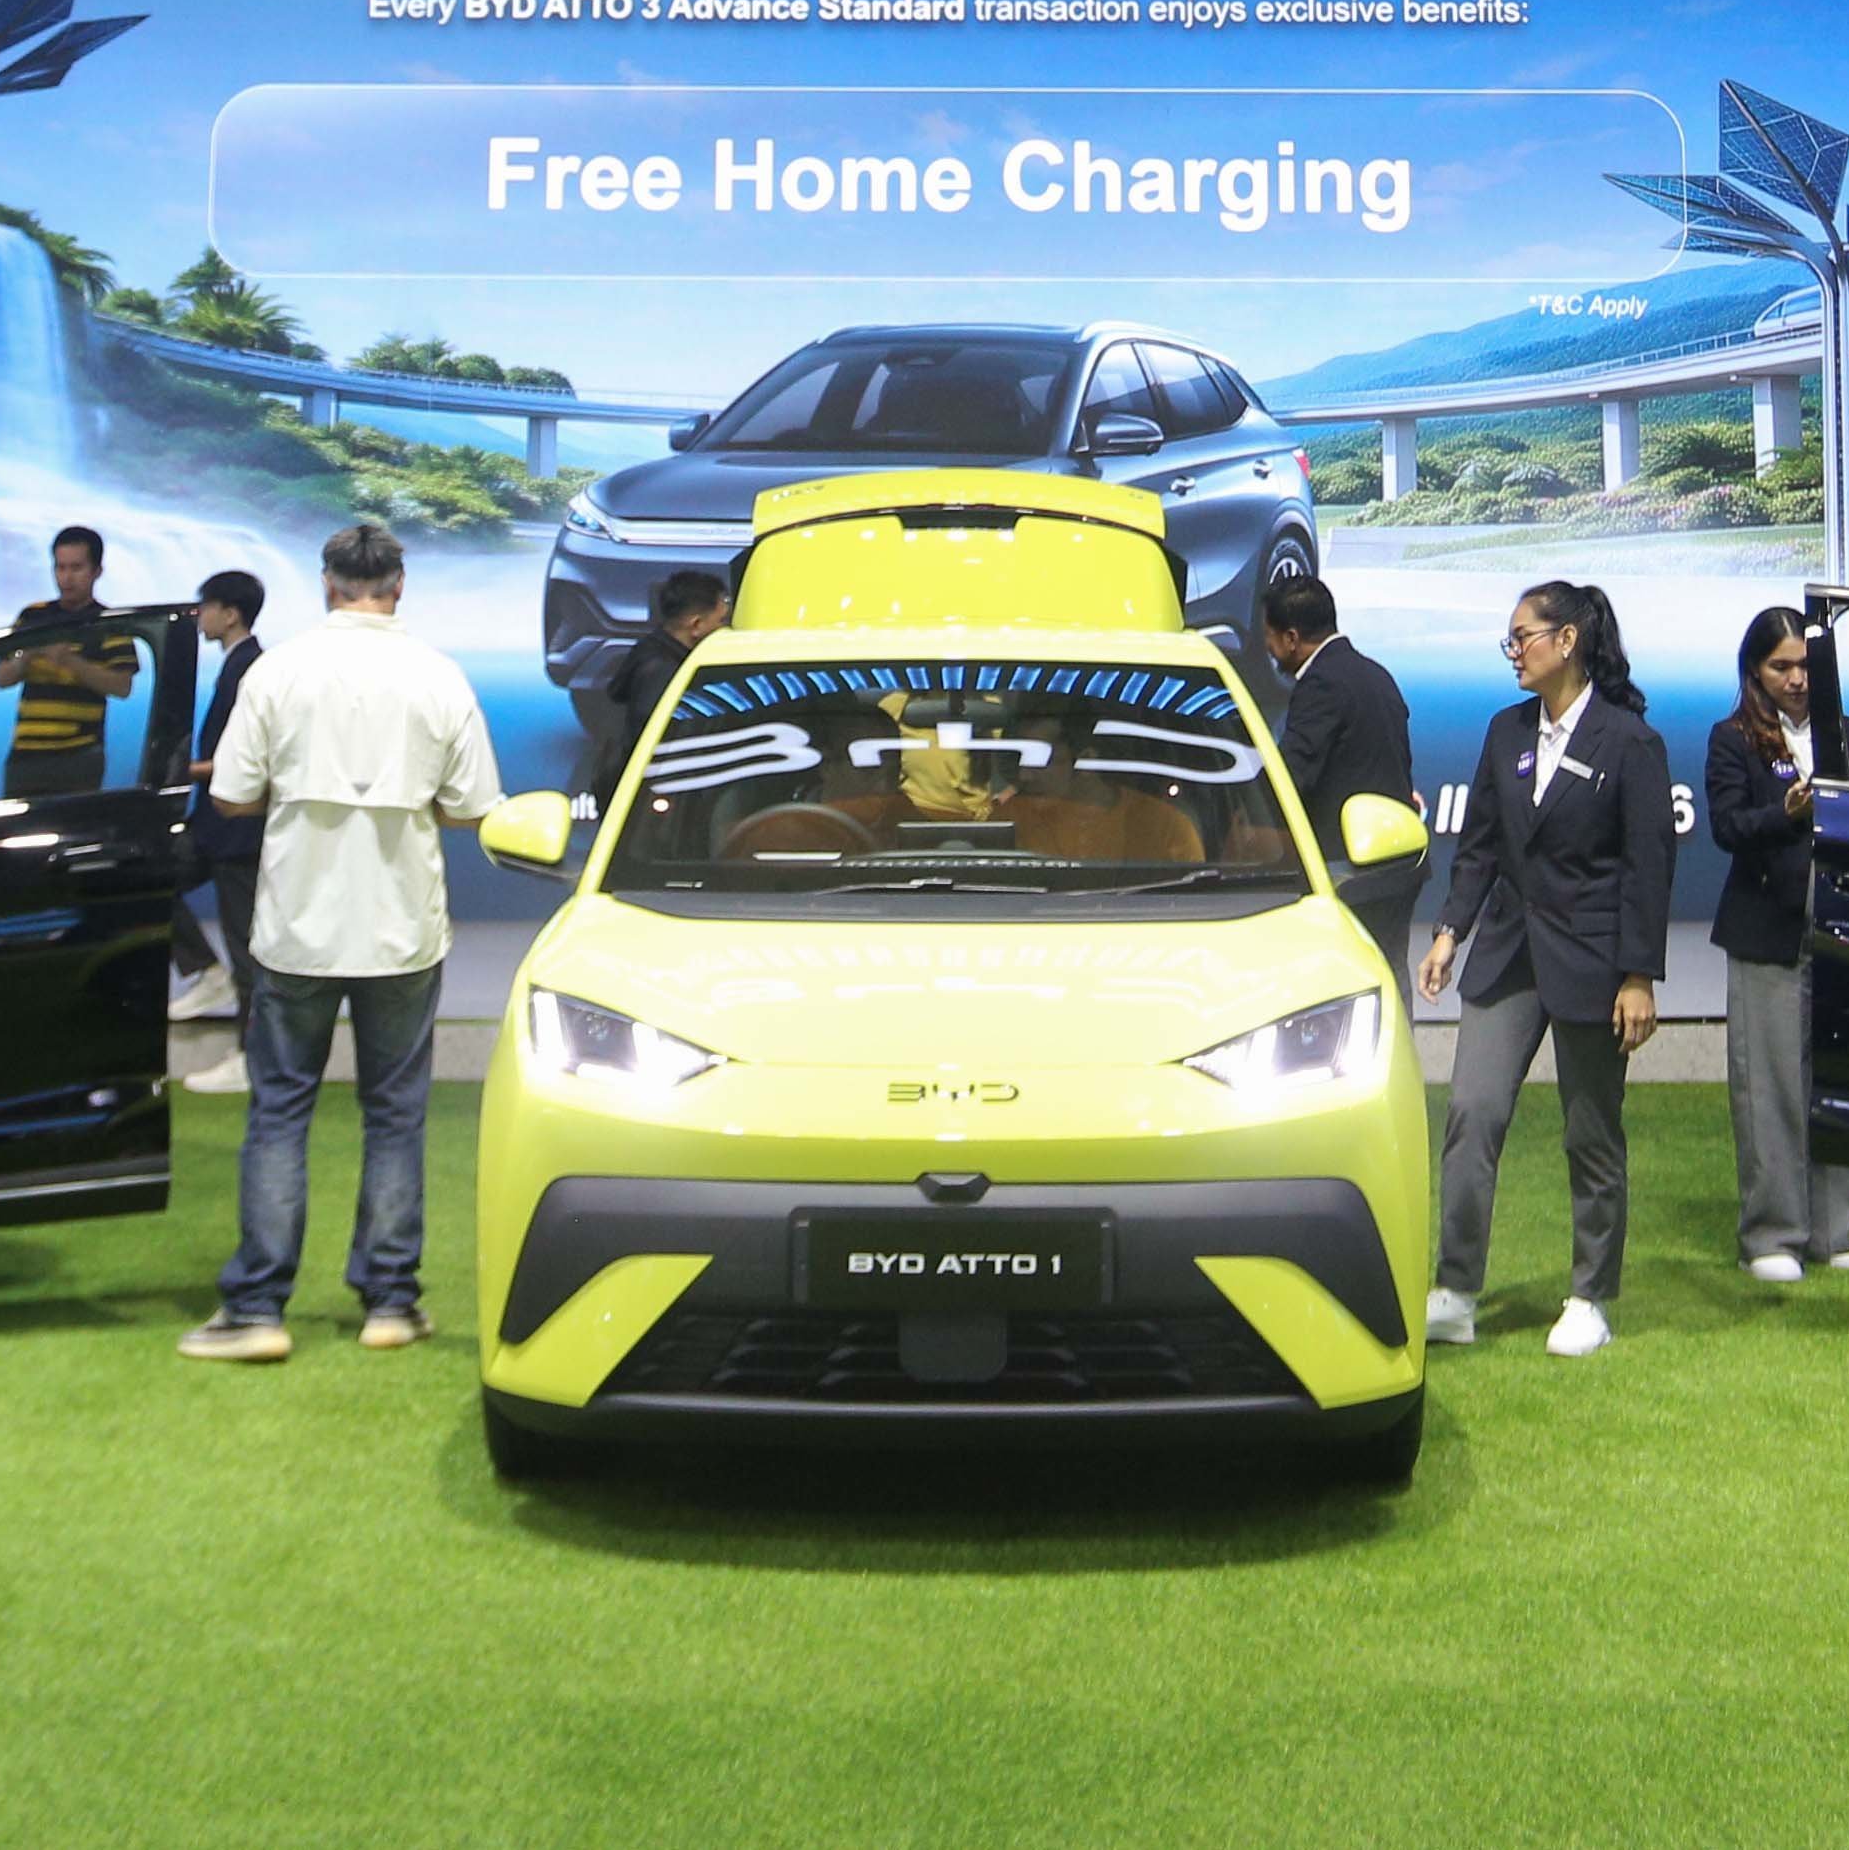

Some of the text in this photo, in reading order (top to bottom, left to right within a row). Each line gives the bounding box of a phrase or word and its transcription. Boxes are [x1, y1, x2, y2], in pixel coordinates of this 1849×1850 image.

[487, 137, 1411, 233] Free Home Charging
[1587, 295, 1648, 321] Apply
[887, 1083, 1020, 1102] BYD
[848, 1253, 1061, 1275] BYD ATTO 1
